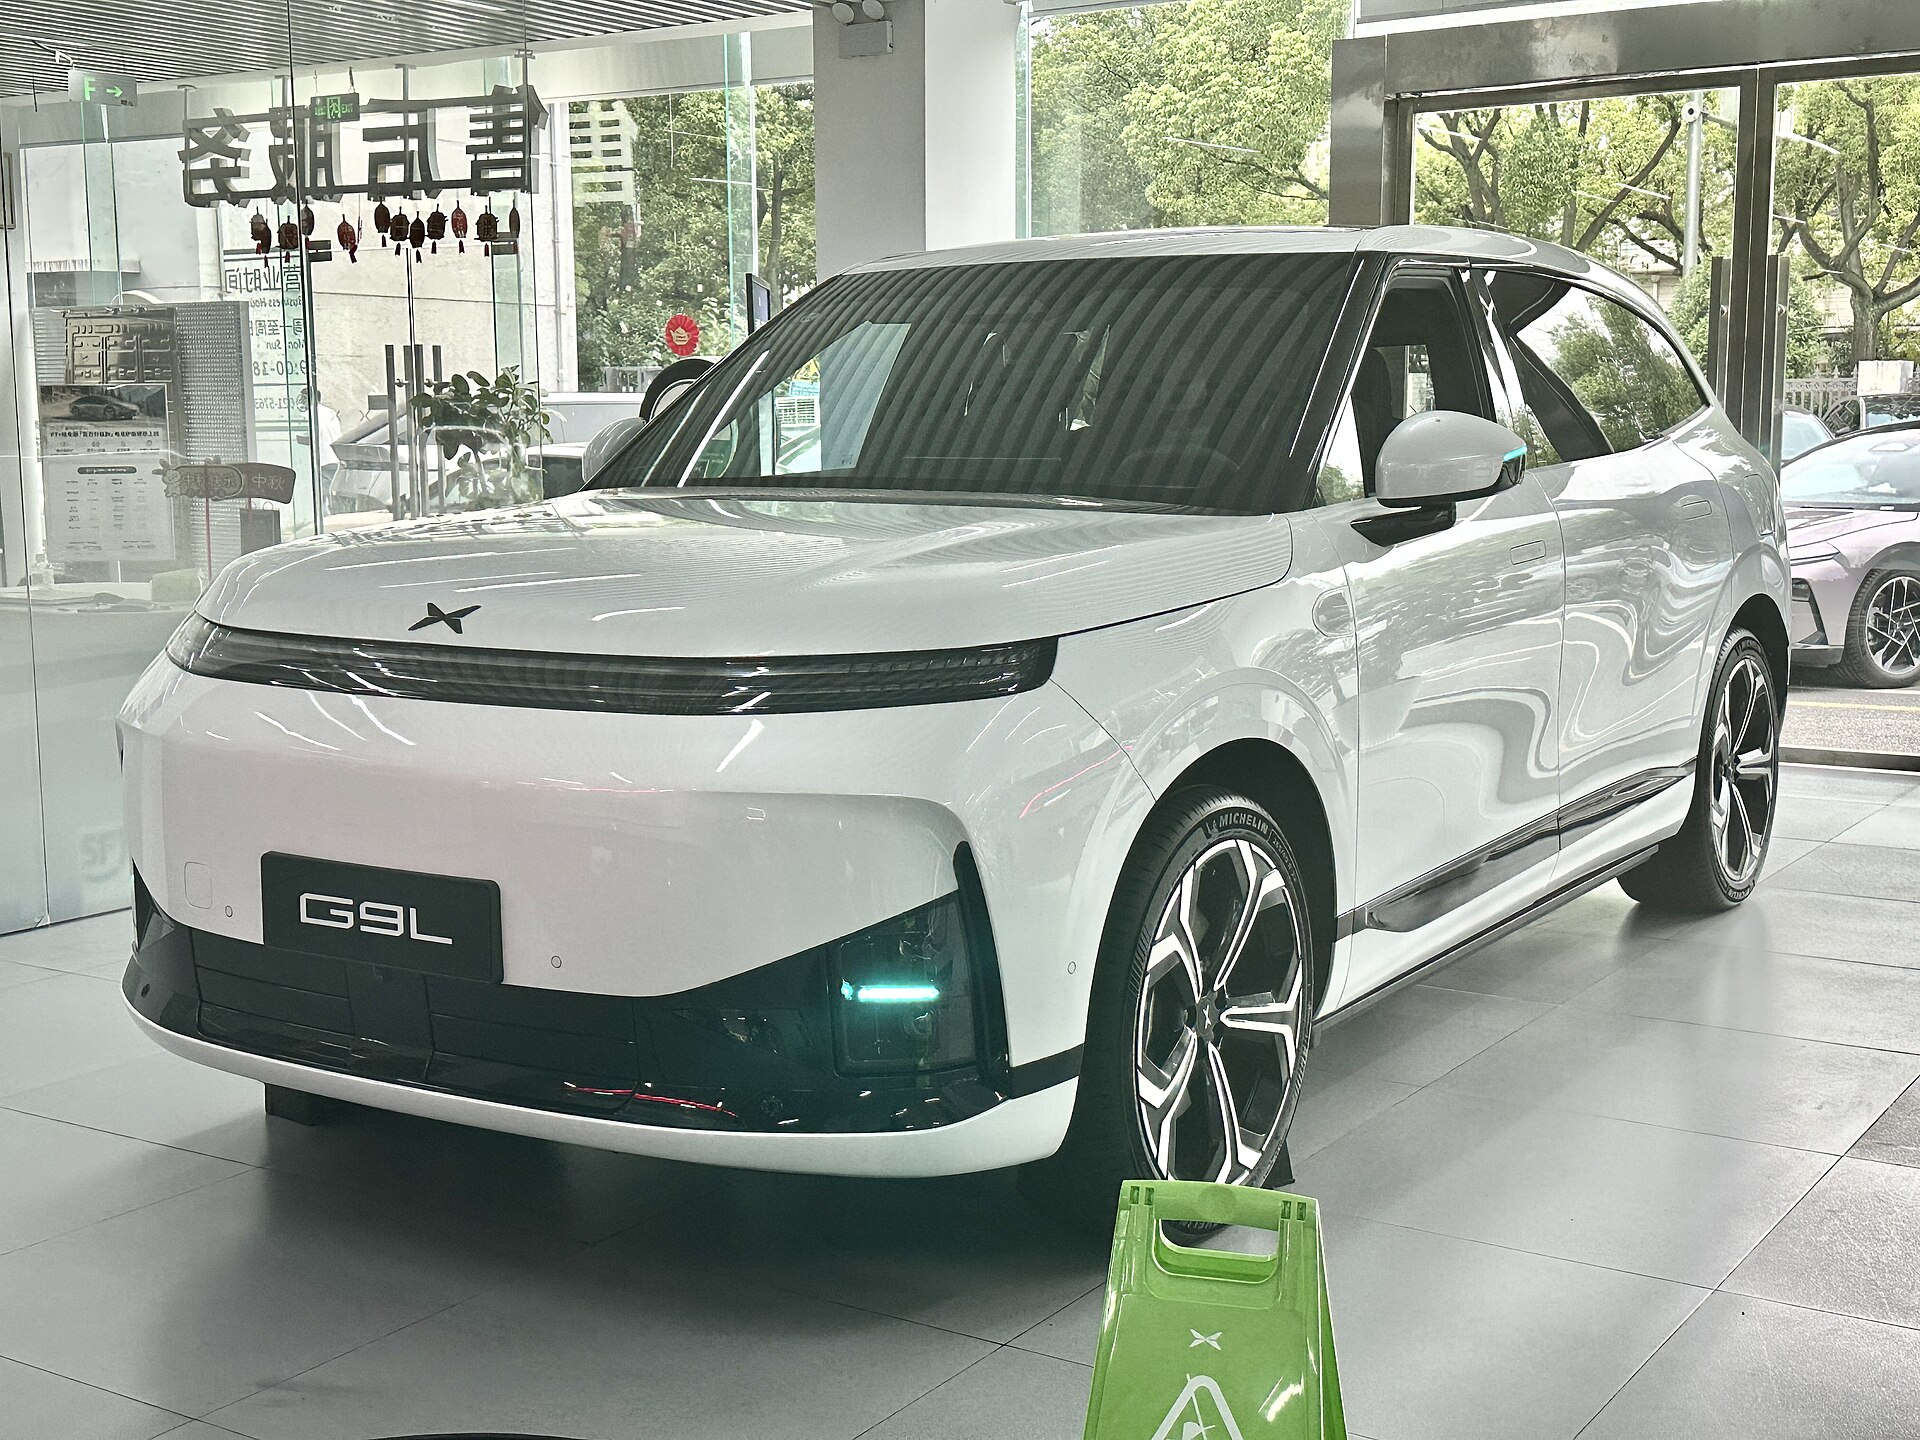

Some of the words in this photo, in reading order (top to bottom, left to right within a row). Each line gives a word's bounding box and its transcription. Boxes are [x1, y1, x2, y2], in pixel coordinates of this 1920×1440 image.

[252, 474, 285, 491] 中秋
[1220, 812, 1269, 834] MICHELIN
[300, 892, 453, 945] G9L
